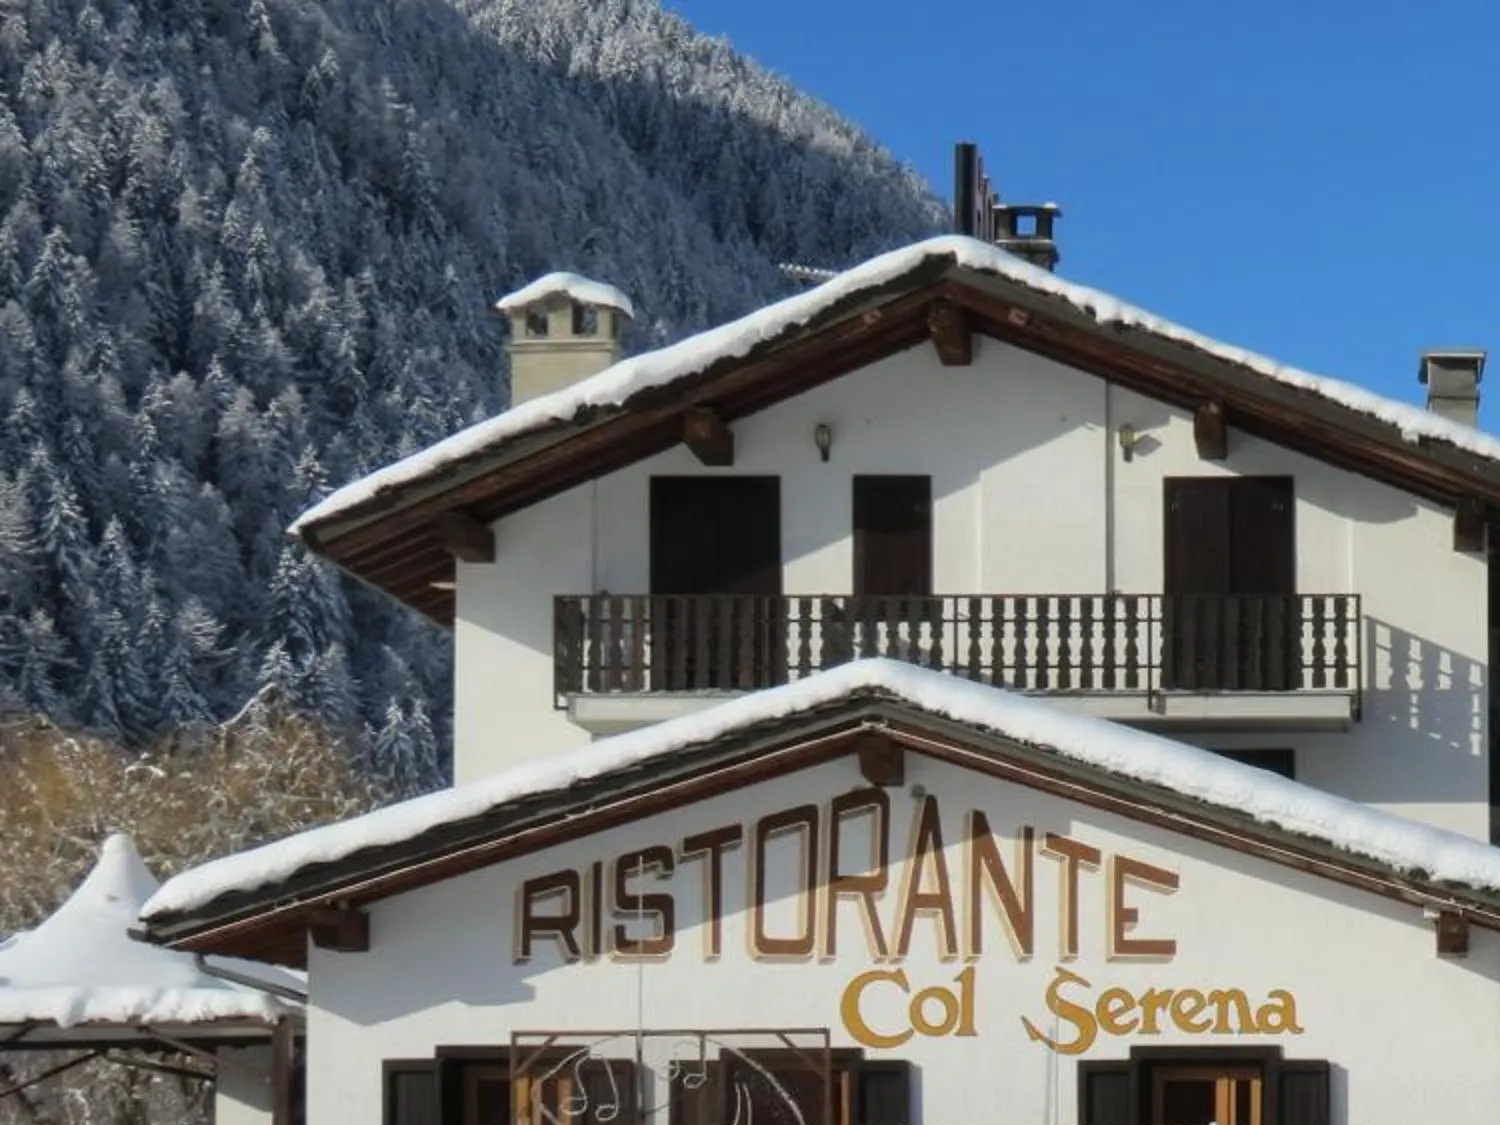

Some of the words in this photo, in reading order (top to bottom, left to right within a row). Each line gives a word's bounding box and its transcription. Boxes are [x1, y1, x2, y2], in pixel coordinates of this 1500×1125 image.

[515, 787, 1180, 963] RISTORANTE
[840, 965, 978, 1049] Col
[1021, 966, 1304, 1055] Serena
